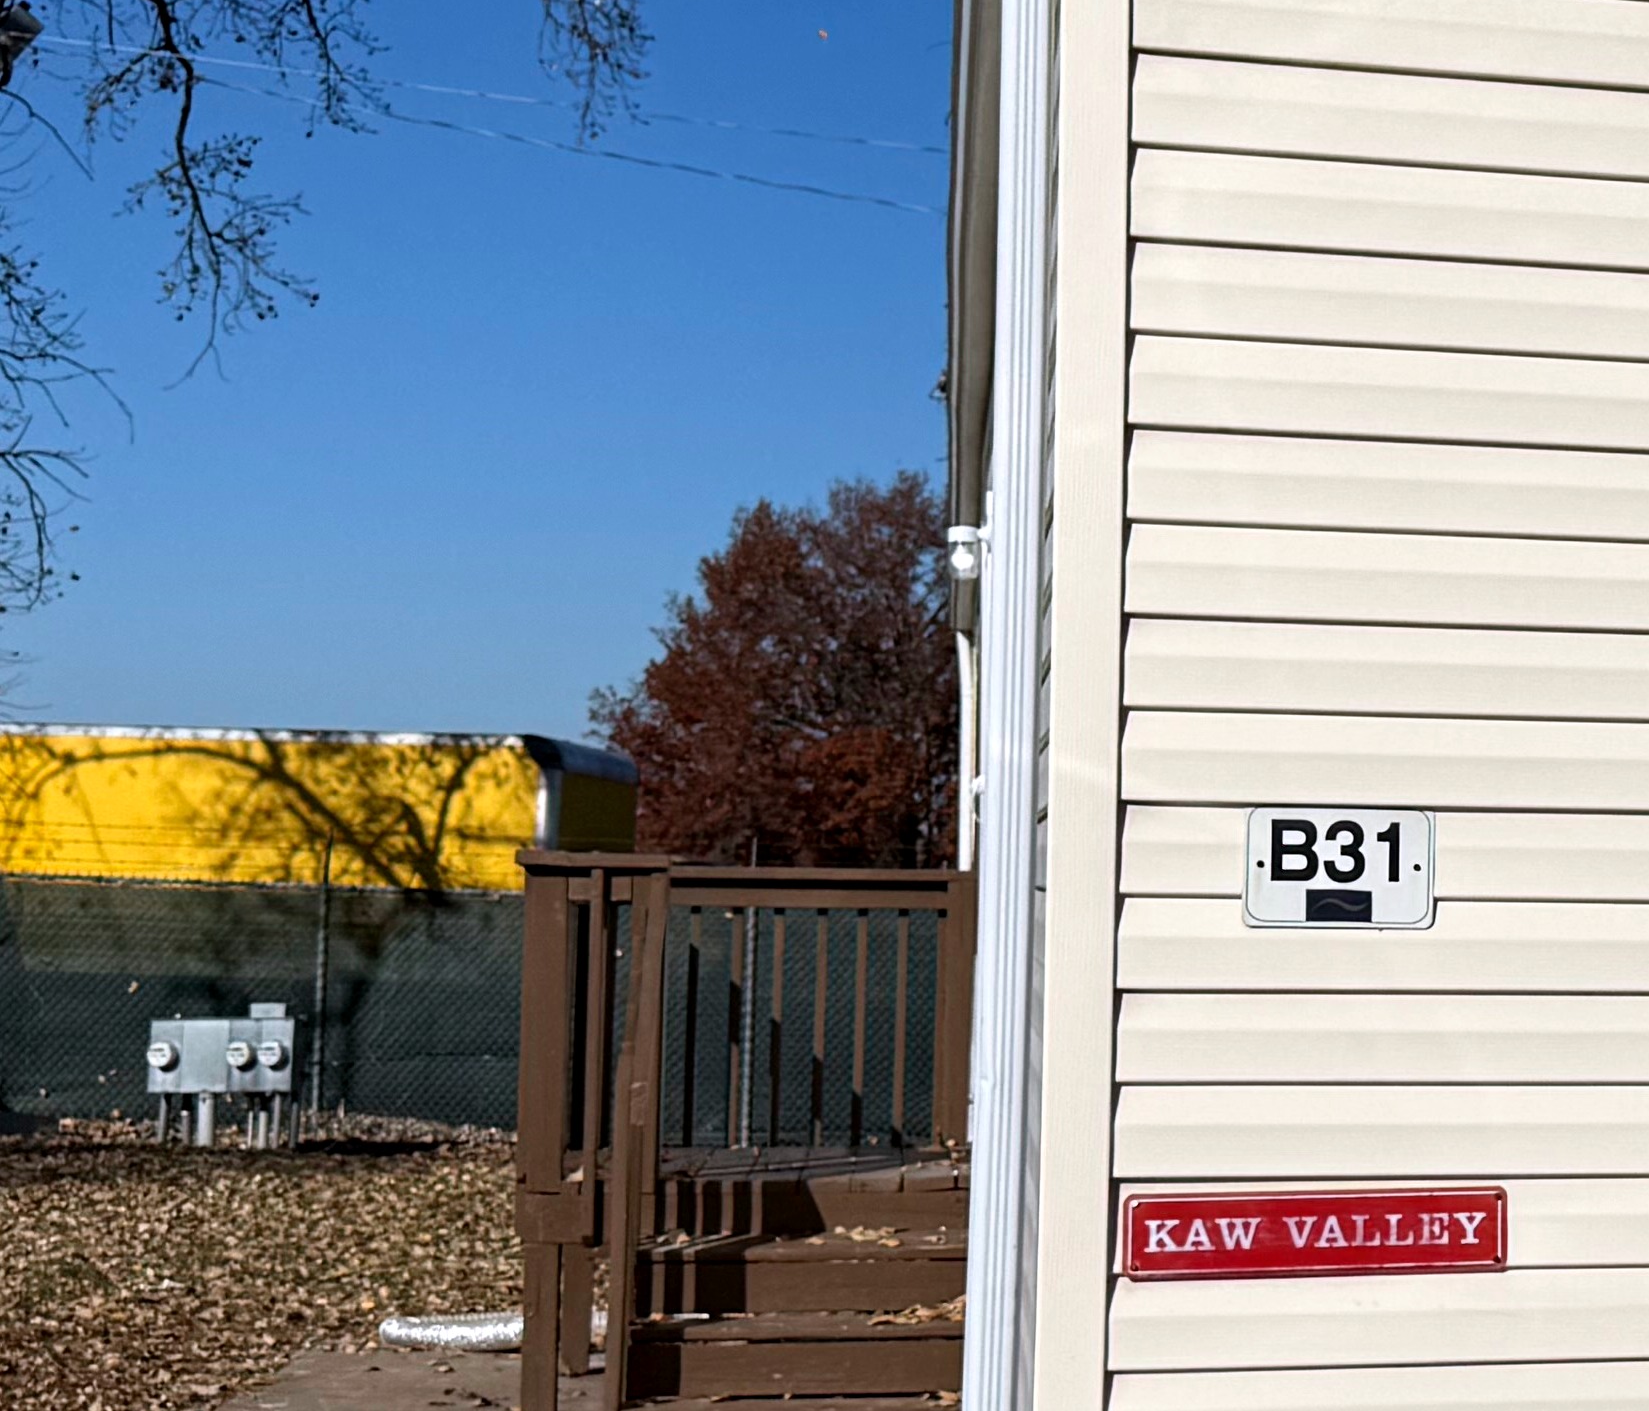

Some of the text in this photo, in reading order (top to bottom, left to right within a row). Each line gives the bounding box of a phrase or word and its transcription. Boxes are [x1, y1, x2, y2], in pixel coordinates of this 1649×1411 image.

[1270, 819, 1400, 884] B31
[1143, 1212, 1487, 1254] KAW VALLEY
